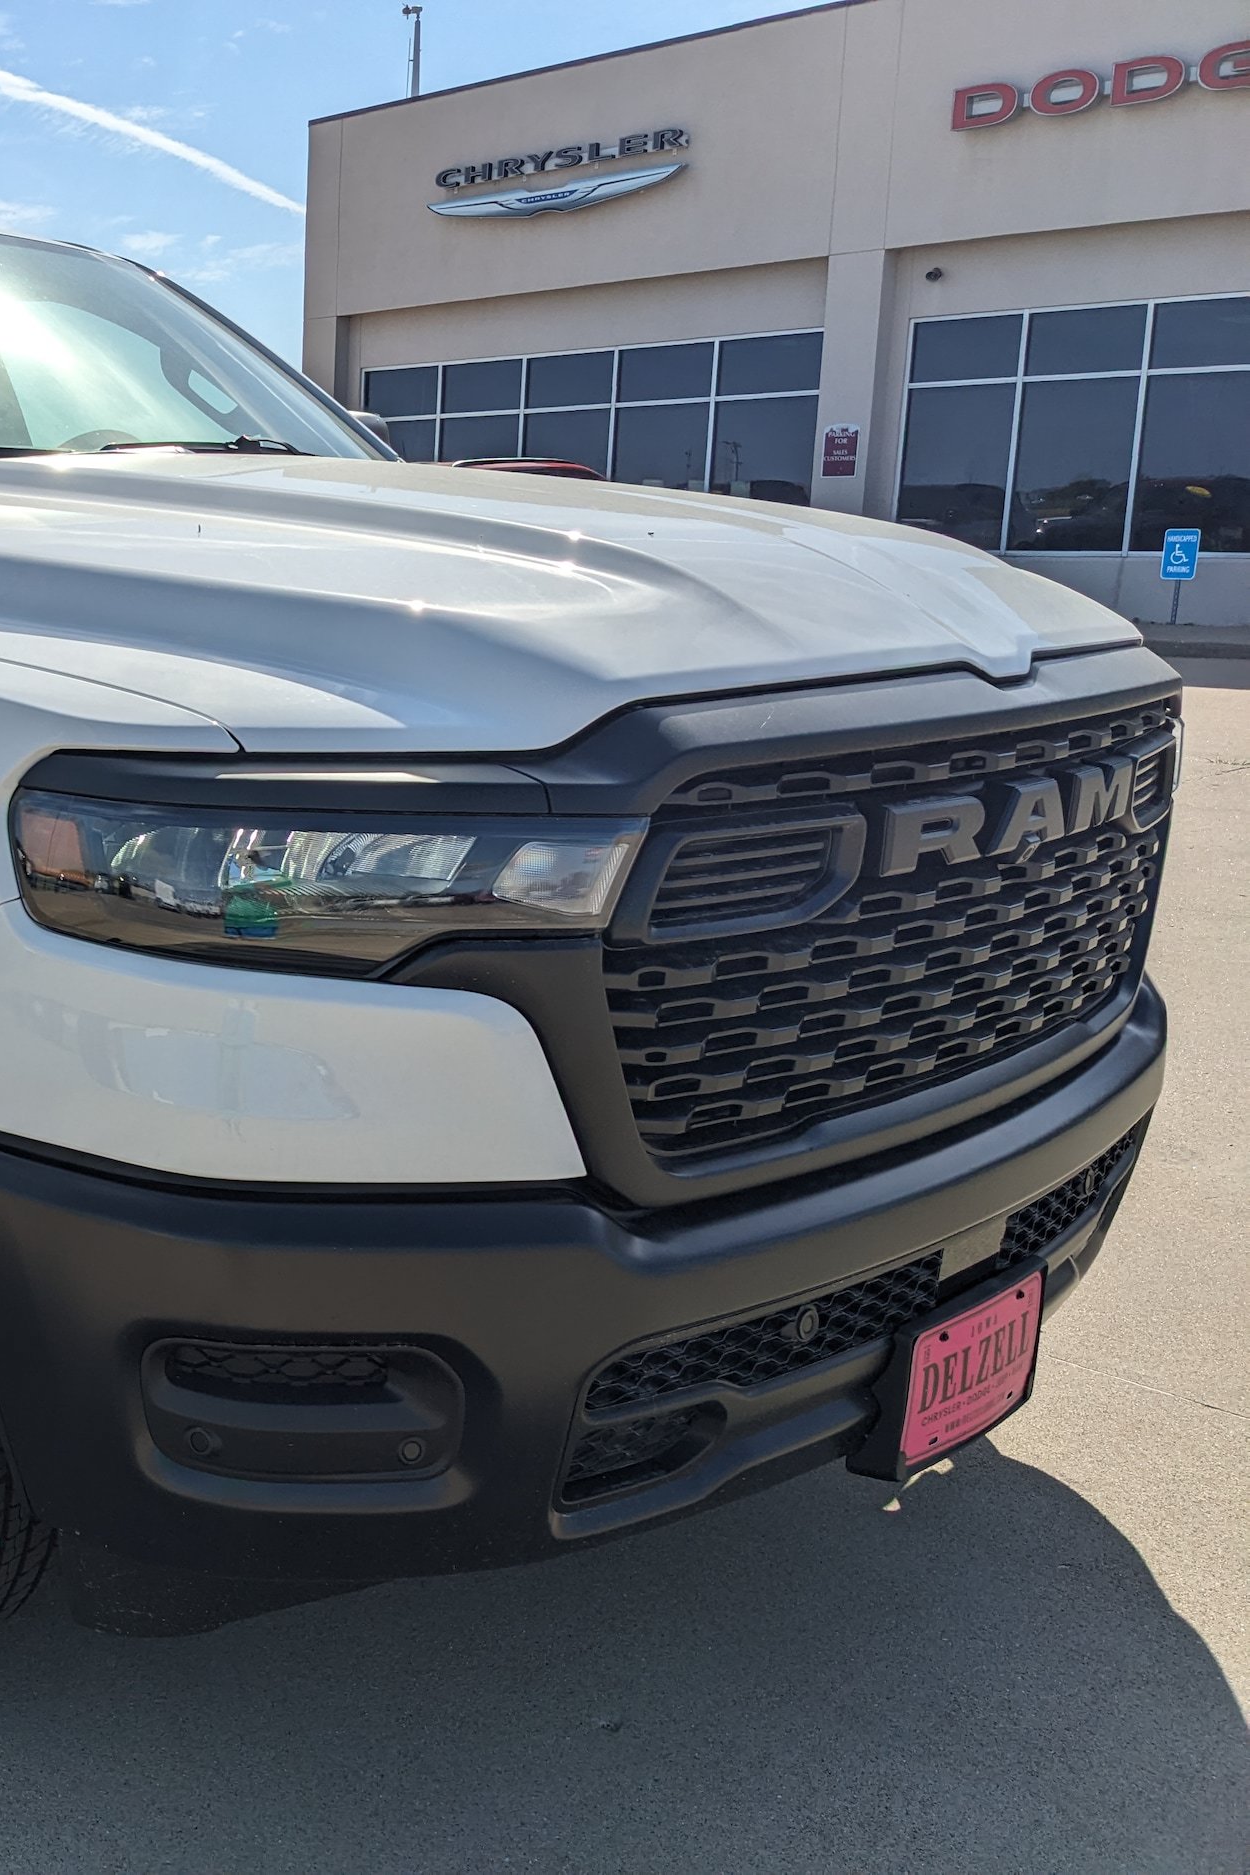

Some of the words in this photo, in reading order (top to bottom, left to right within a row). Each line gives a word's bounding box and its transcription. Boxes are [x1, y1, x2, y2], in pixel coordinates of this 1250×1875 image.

[435, 129, 686, 189] CHRYSLER
[521, 191, 570, 203] CHRYSLER
[880, 755, 1134, 877] RAM
[917, 1311, 1030, 1414] DELZELL
[921, 1401, 961, 1426] CHRYSLER
